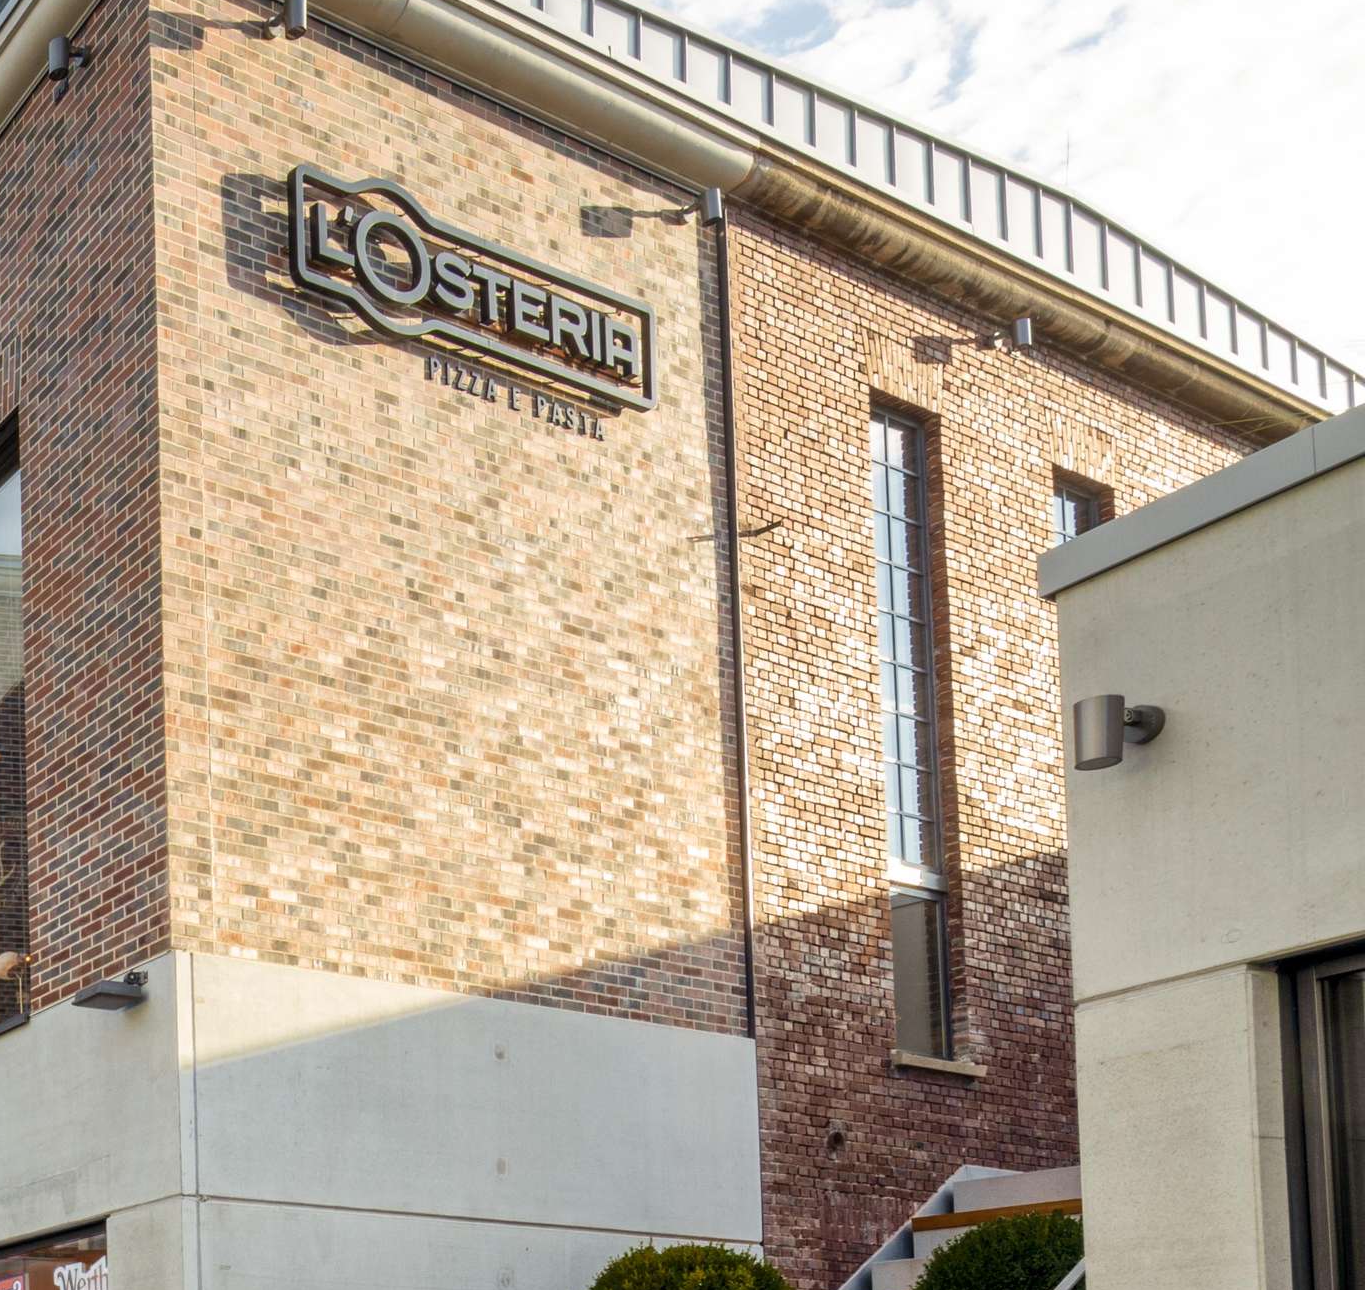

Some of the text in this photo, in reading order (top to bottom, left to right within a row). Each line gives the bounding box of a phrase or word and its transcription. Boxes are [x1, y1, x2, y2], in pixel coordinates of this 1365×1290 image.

[310, 200, 640, 378] L'OSTERIA
[425, 357, 607, 442] PIZZA E PASTA
